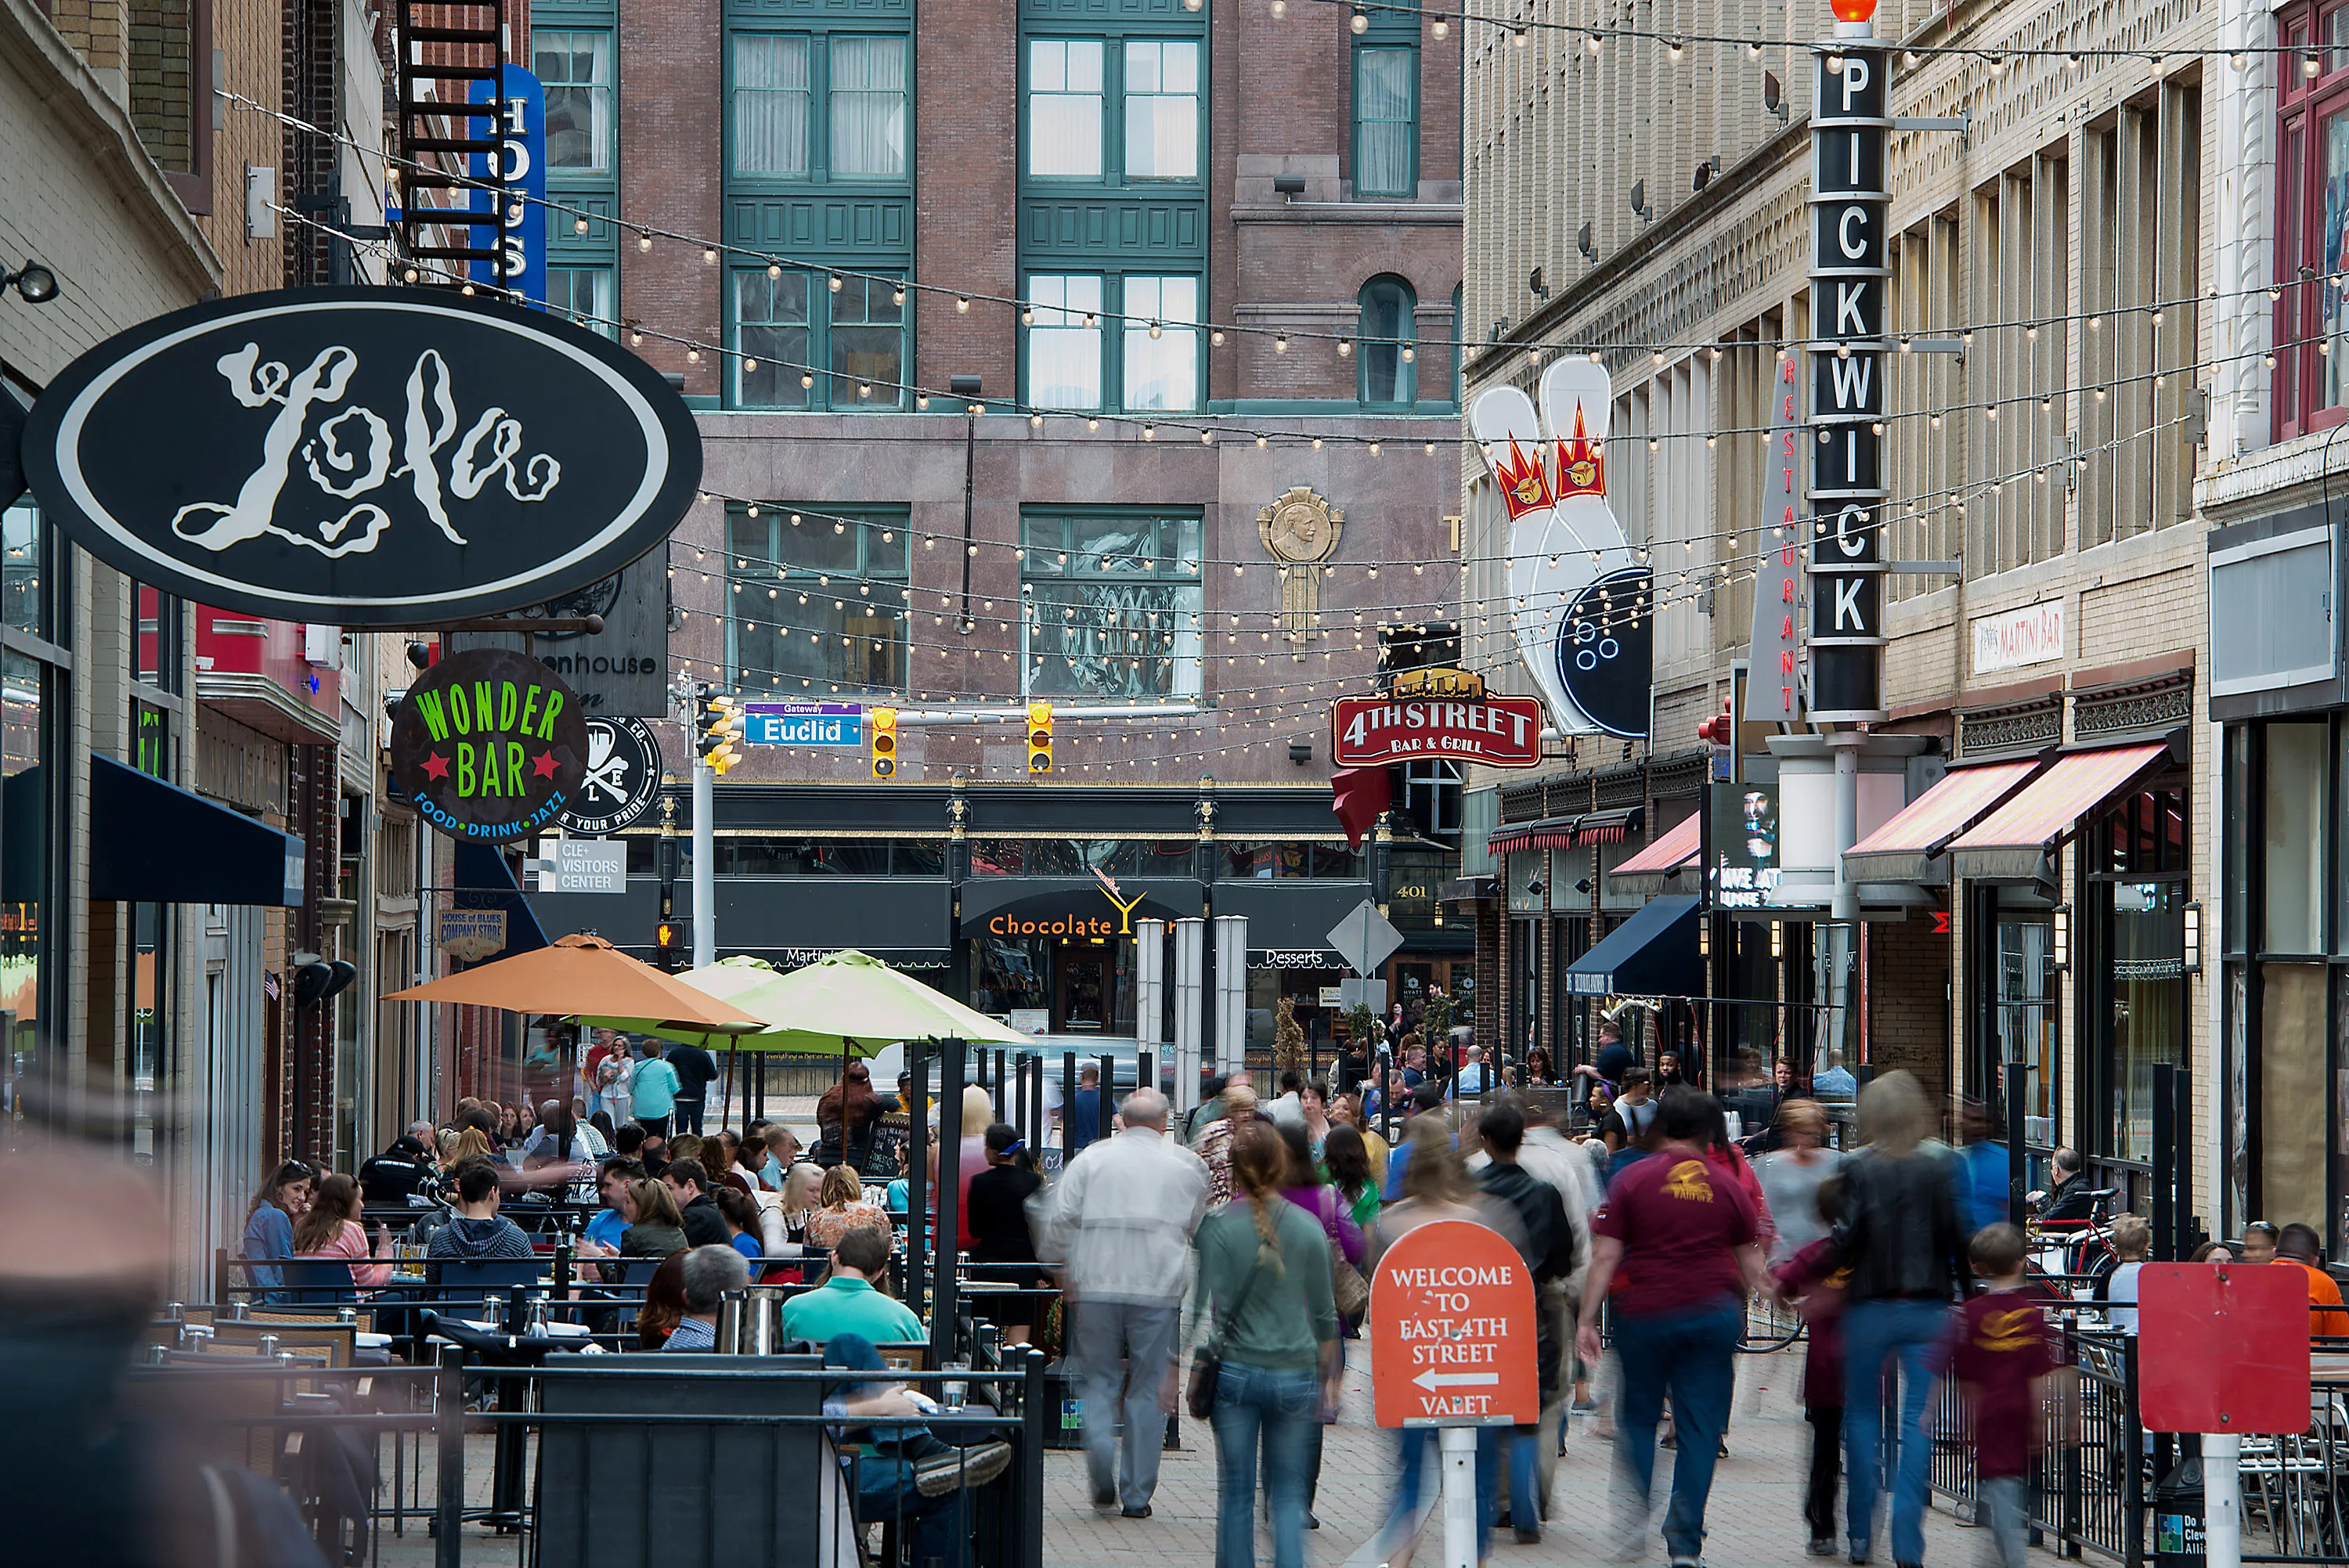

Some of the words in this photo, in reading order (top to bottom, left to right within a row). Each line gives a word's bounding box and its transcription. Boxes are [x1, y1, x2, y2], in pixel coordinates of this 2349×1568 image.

[1831, 59, 1871, 630] PICKWICK
[171, 342, 561, 558] Lola
[1781, 358, 1795, 711] RESTAURANT
[2000, 617, 2038, 661] MARTINI
[2041, 609, 2060, 652] BAR
[415, 681, 565, 742] WONDER
[784, 705, 823, 714] Gateway
[764, 719, 841, 741] Euclid
[1343, 704, 1402, 748] 4TH
[1405, 702, 1532, 748] STREET
[1390, 739, 1421, 754] BAR
[1426, 737, 1437, 749] &
[1441, 735, 1483, 754] GRILL
[457, 742, 526, 798] BAR
[414, 791, 457, 830] FOOD
[467, 820, 523, 838] DRINK
[529, 790, 567, 827] JAZZ
[576, 818, 608, 831] YOUR
[614, 797, 646, 826] PRIDE
[561, 844, 589, 857] CLE+
[561, 860, 619, 874] VISITORS
[561, 875, 612, 889] CENTER
[1397, 885, 1427, 898] 401
[442, 913, 467, 923] HOUSE
[468, 914, 476, 923] of
[478, 914, 502, 923] BLUES
[989, 914, 1112, 935] Chocolate
[441, 925, 477, 943] COMPANY
[478, 925, 502, 944] STORE
[1266, 950, 1323, 964] Desserts
[1391, 1266, 1512, 1288] WELCOME
[1434, 1292, 1470, 1312] TO
[1399, 1318, 1455, 1339] EAST
[1460, 1317, 1508, 1337] 4TH
[1412, 1343, 1497, 1364] STREET
[1420, 1395, 1492, 1415] VALET
